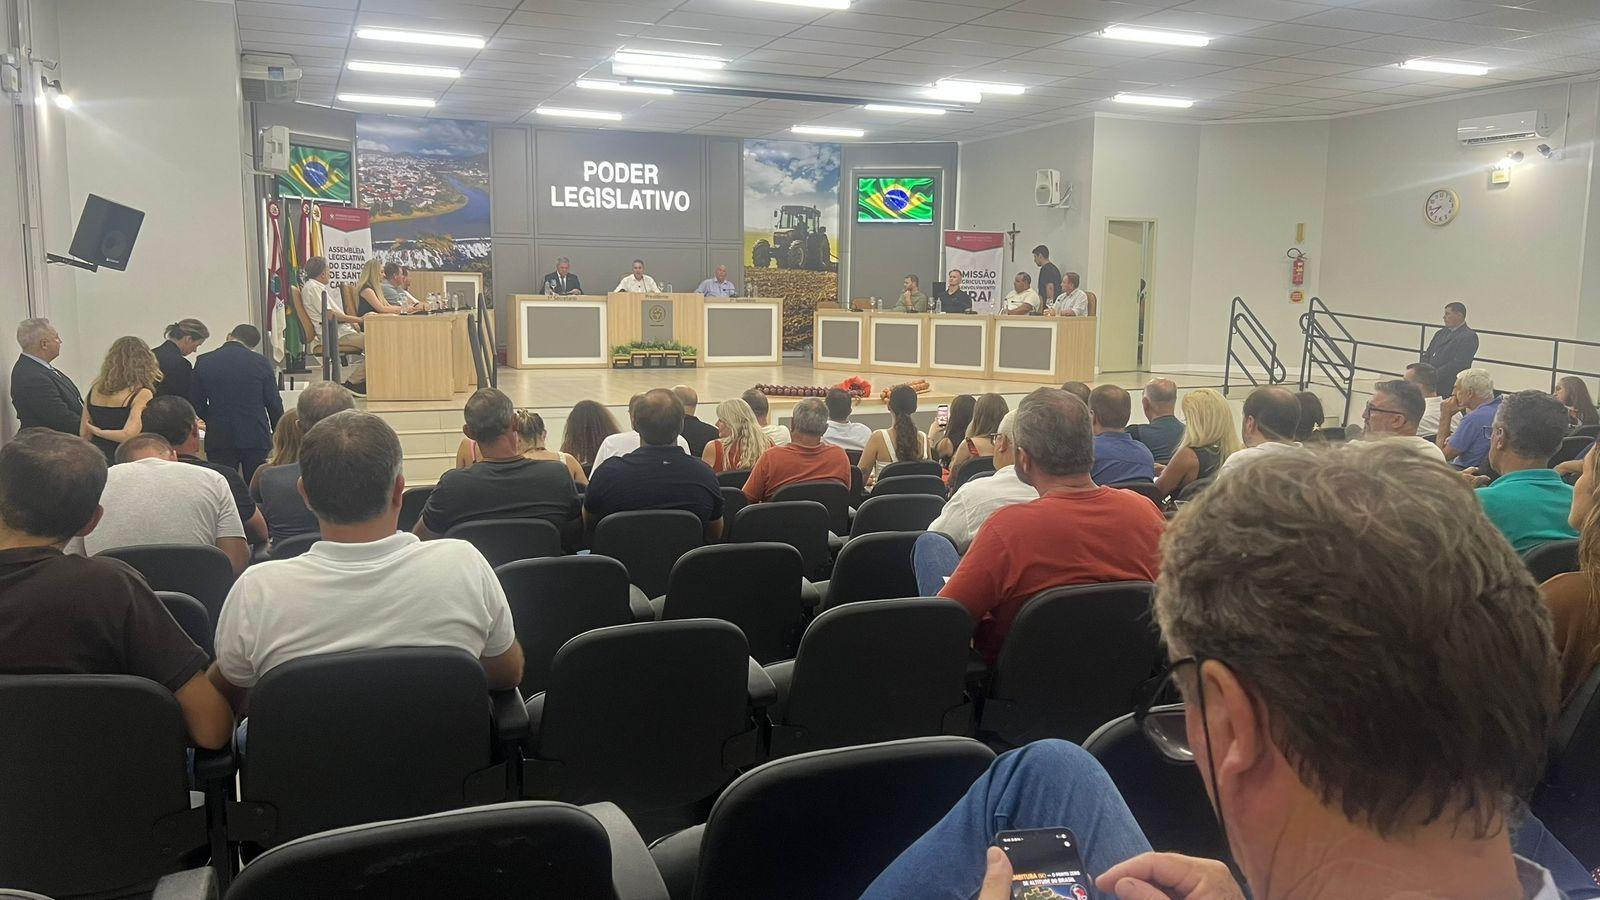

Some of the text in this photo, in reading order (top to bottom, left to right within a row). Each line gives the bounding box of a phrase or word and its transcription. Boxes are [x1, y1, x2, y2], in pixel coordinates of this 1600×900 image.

[583, 160, 659, 185] PODER
[550, 185, 691, 212] LEGISLATIVO
[328, 246, 365, 255] ASSEMBLEIA
[328, 254, 366, 262] LEGISLATIVA
[328, 262, 340, 270] DO
[329, 271, 361, 280] DE SANT
[962, 269, 996, 279] MISSÃO
[1012, 872, 1038, 880] MBITUBA
